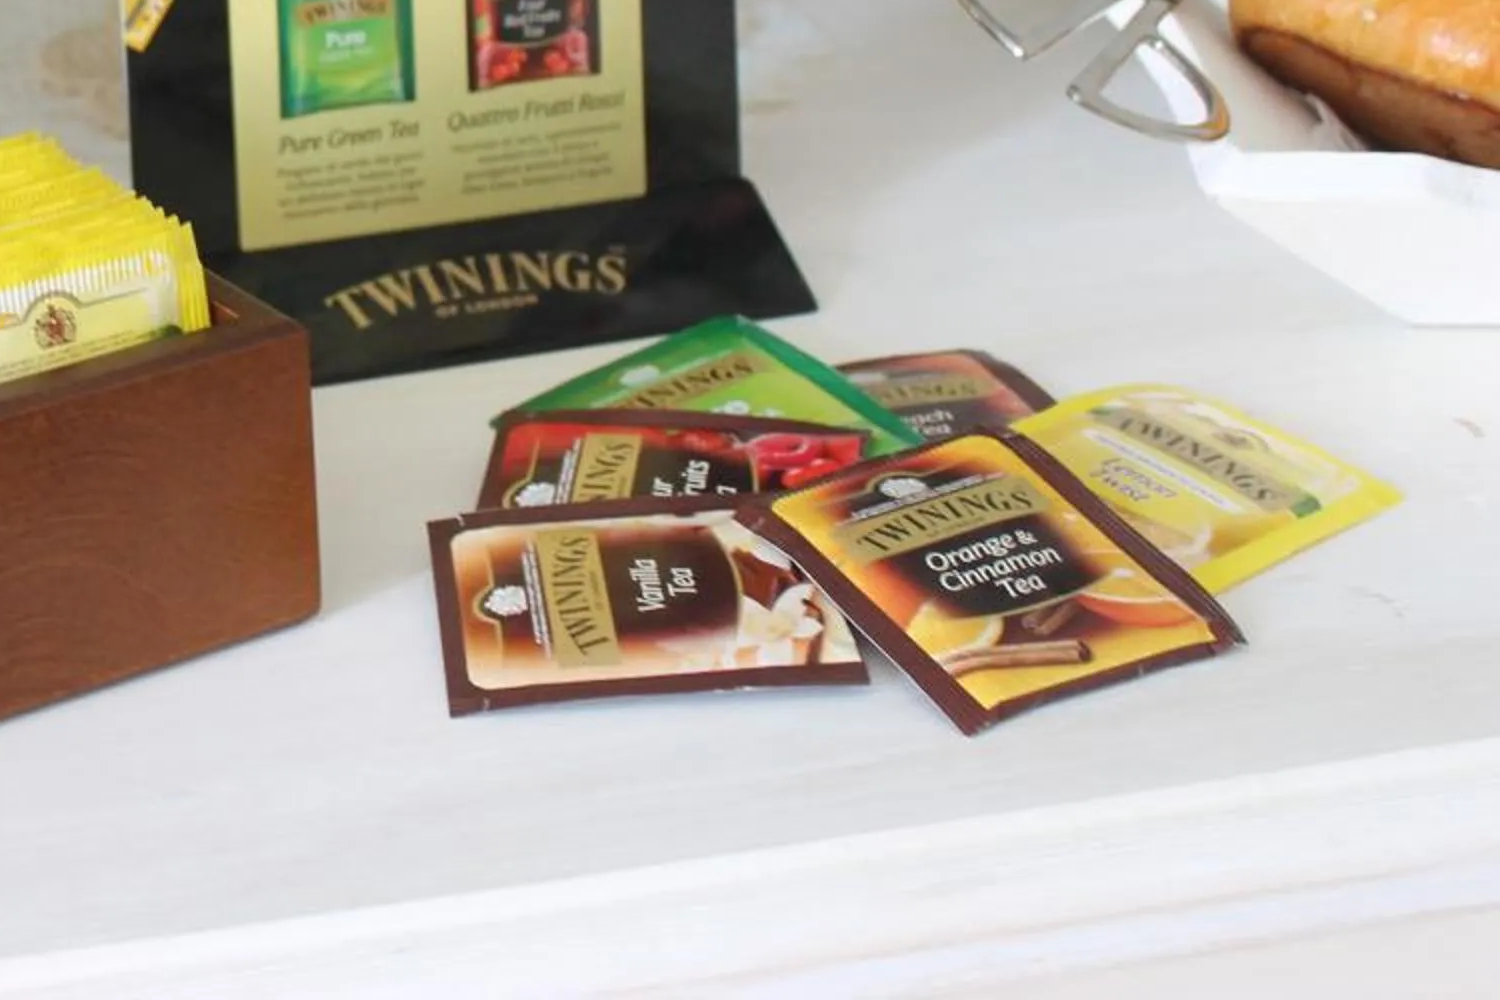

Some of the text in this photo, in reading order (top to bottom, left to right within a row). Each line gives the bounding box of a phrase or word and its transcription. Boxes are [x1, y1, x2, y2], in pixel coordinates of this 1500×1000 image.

[278, 117, 420, 156] Pure Green Tea
[323, 250, 628, 330] TWININGS
[1118, 416, 1272, 502] TWININGS
[856, 489, 1033, 551] TWININGS
[925, 528, 1038, 572] Orange &
[939, 547, 1064, 592] Cinnamon
[552, 535, 609, 656] TWININGS
[628, 558, 666, 612] Vanilla
[667, 566, 698, 598] Tea
[994, 574, 1048, 599] Tea
